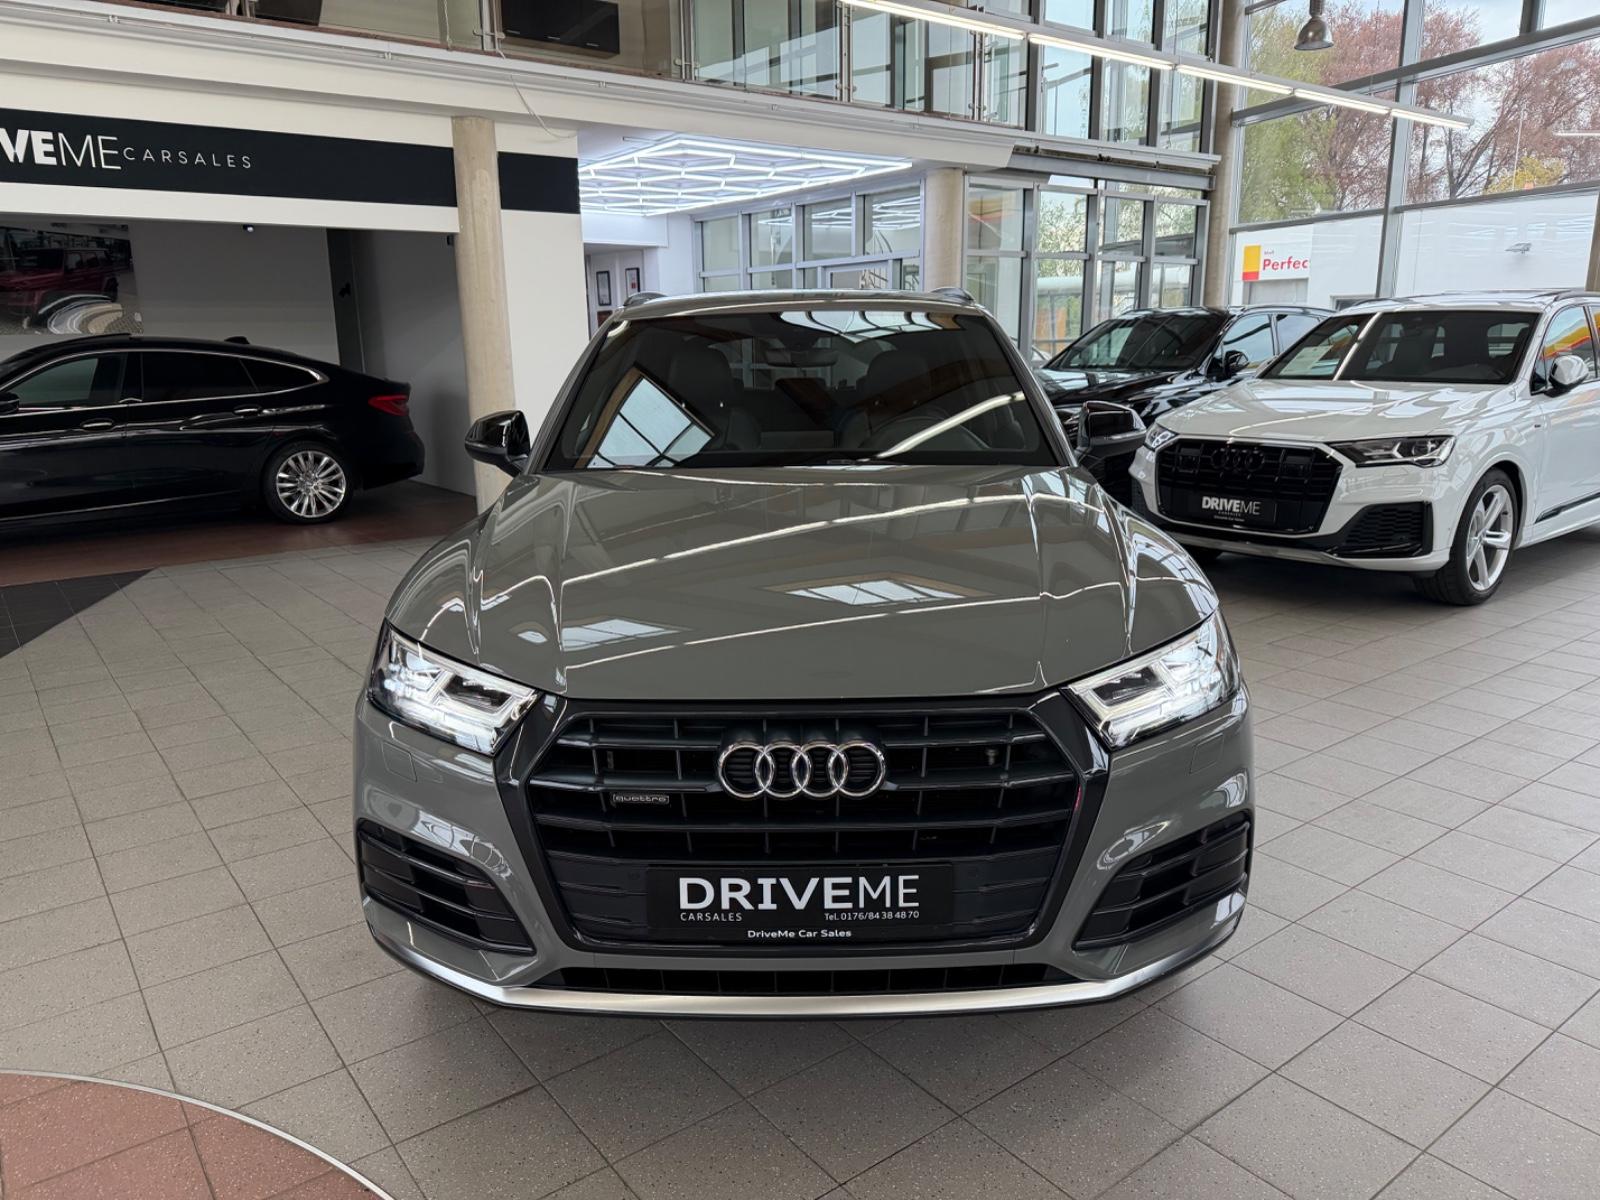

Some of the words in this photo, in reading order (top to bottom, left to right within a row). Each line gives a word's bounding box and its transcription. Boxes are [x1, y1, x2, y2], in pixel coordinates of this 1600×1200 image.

[123, 147, 251, 169] CARSALES
[1201, 495, 1262, 515] DRIVEME
[614, 794, 668, 803] quattro
[678, 874, 920, 911] DRIVEME
[680, 912, 743, 922] CARSALES
[747, 929, 796, 939] DriveMe
[798, 929, 818, 938] Car
[820, 929, 852, 938] Sales
